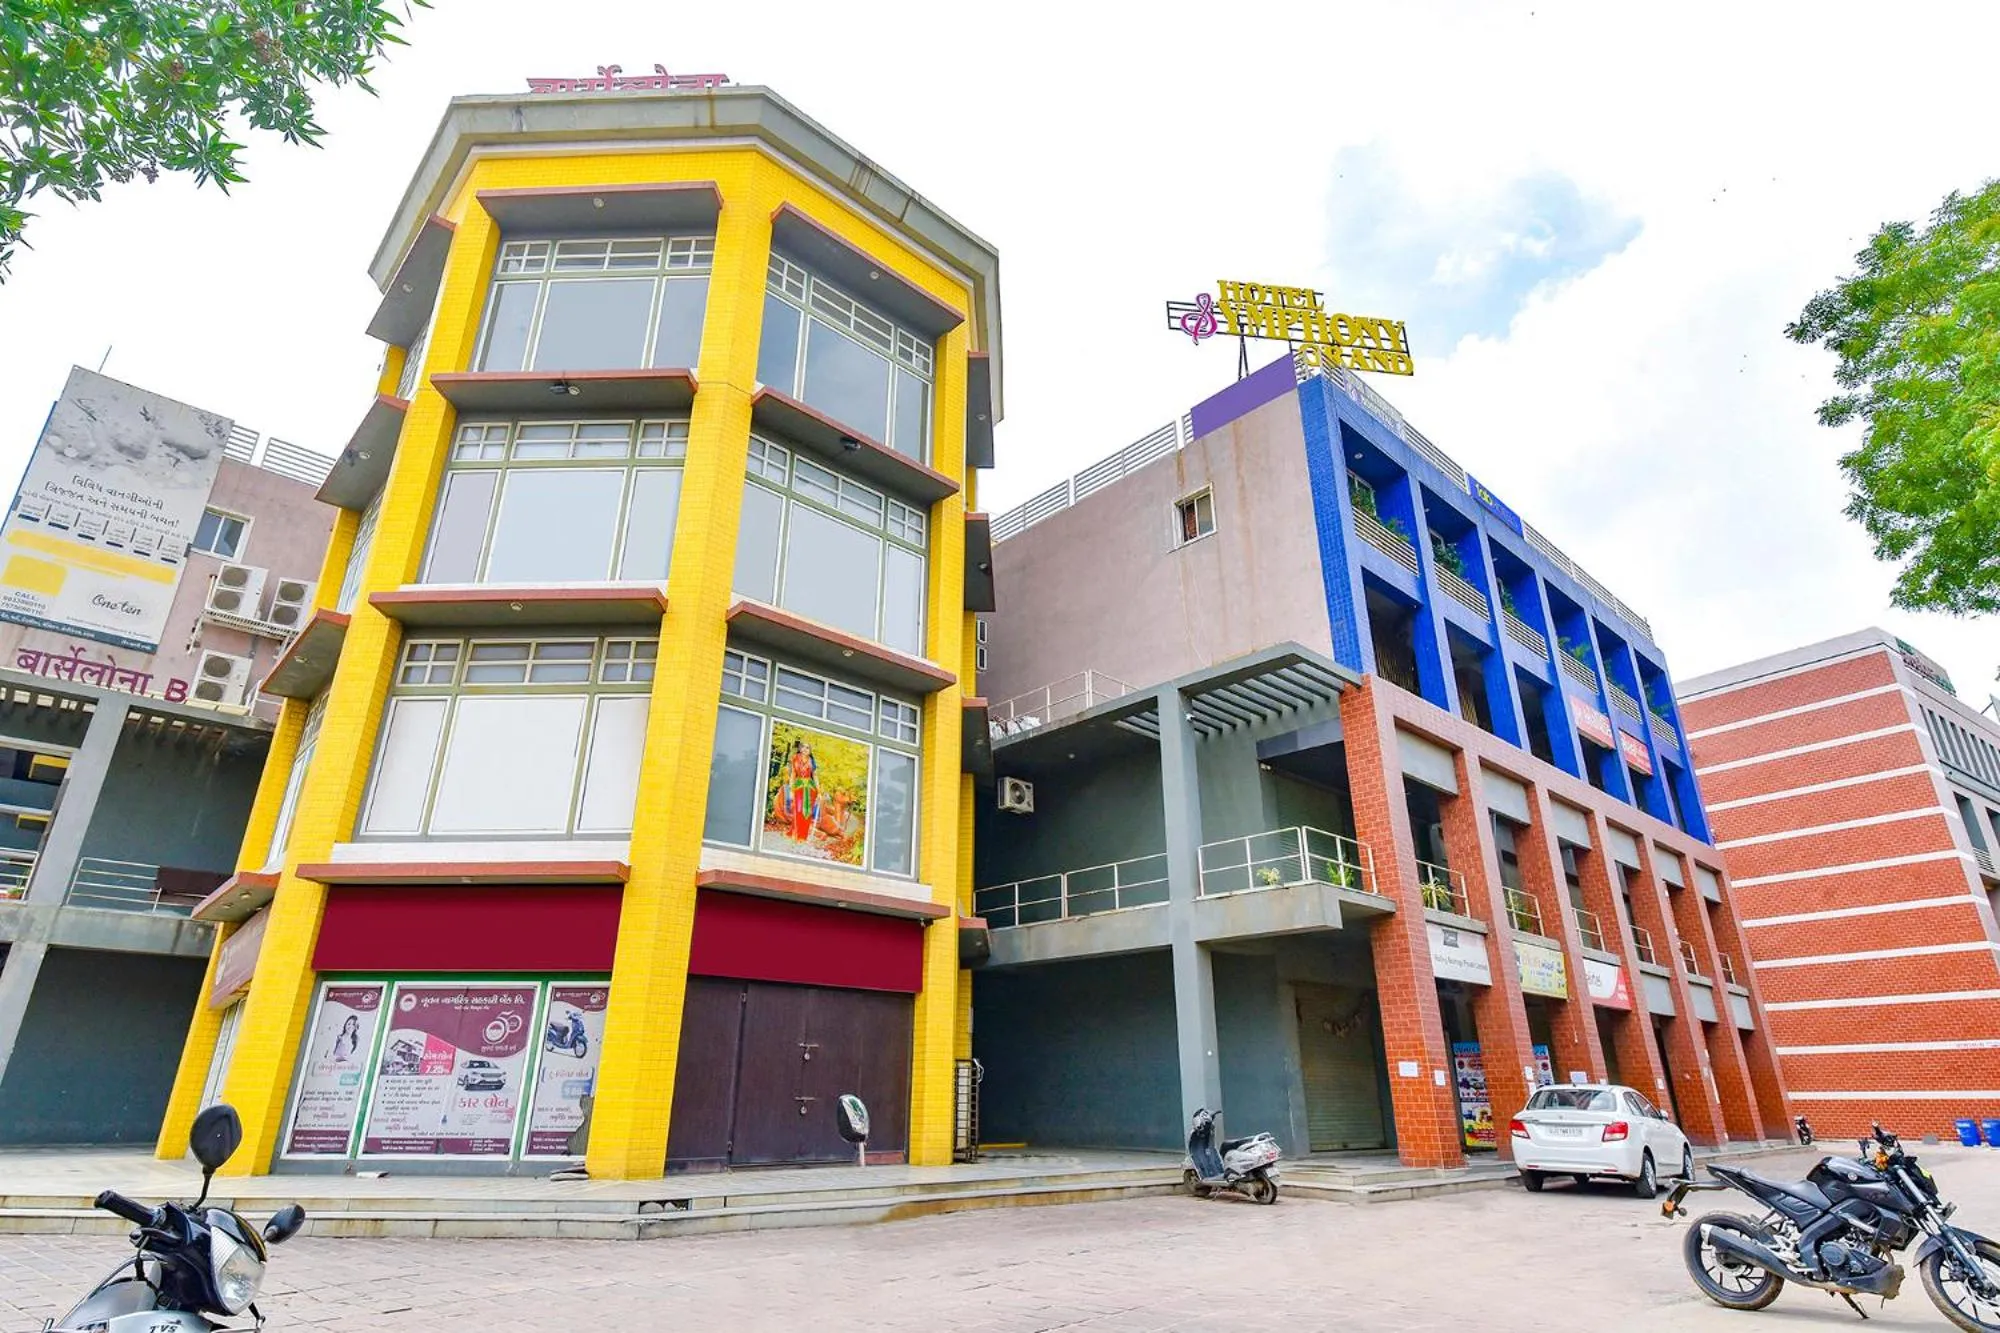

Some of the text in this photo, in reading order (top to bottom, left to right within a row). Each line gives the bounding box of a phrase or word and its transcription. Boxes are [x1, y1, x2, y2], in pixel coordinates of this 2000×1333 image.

[1217, 280, 1324, 311] HOTEL
[1299, 343, 1414, 376] GRAND
[165, 678, 189, 702] B
[149, 1325, 178, 1333] TVS
